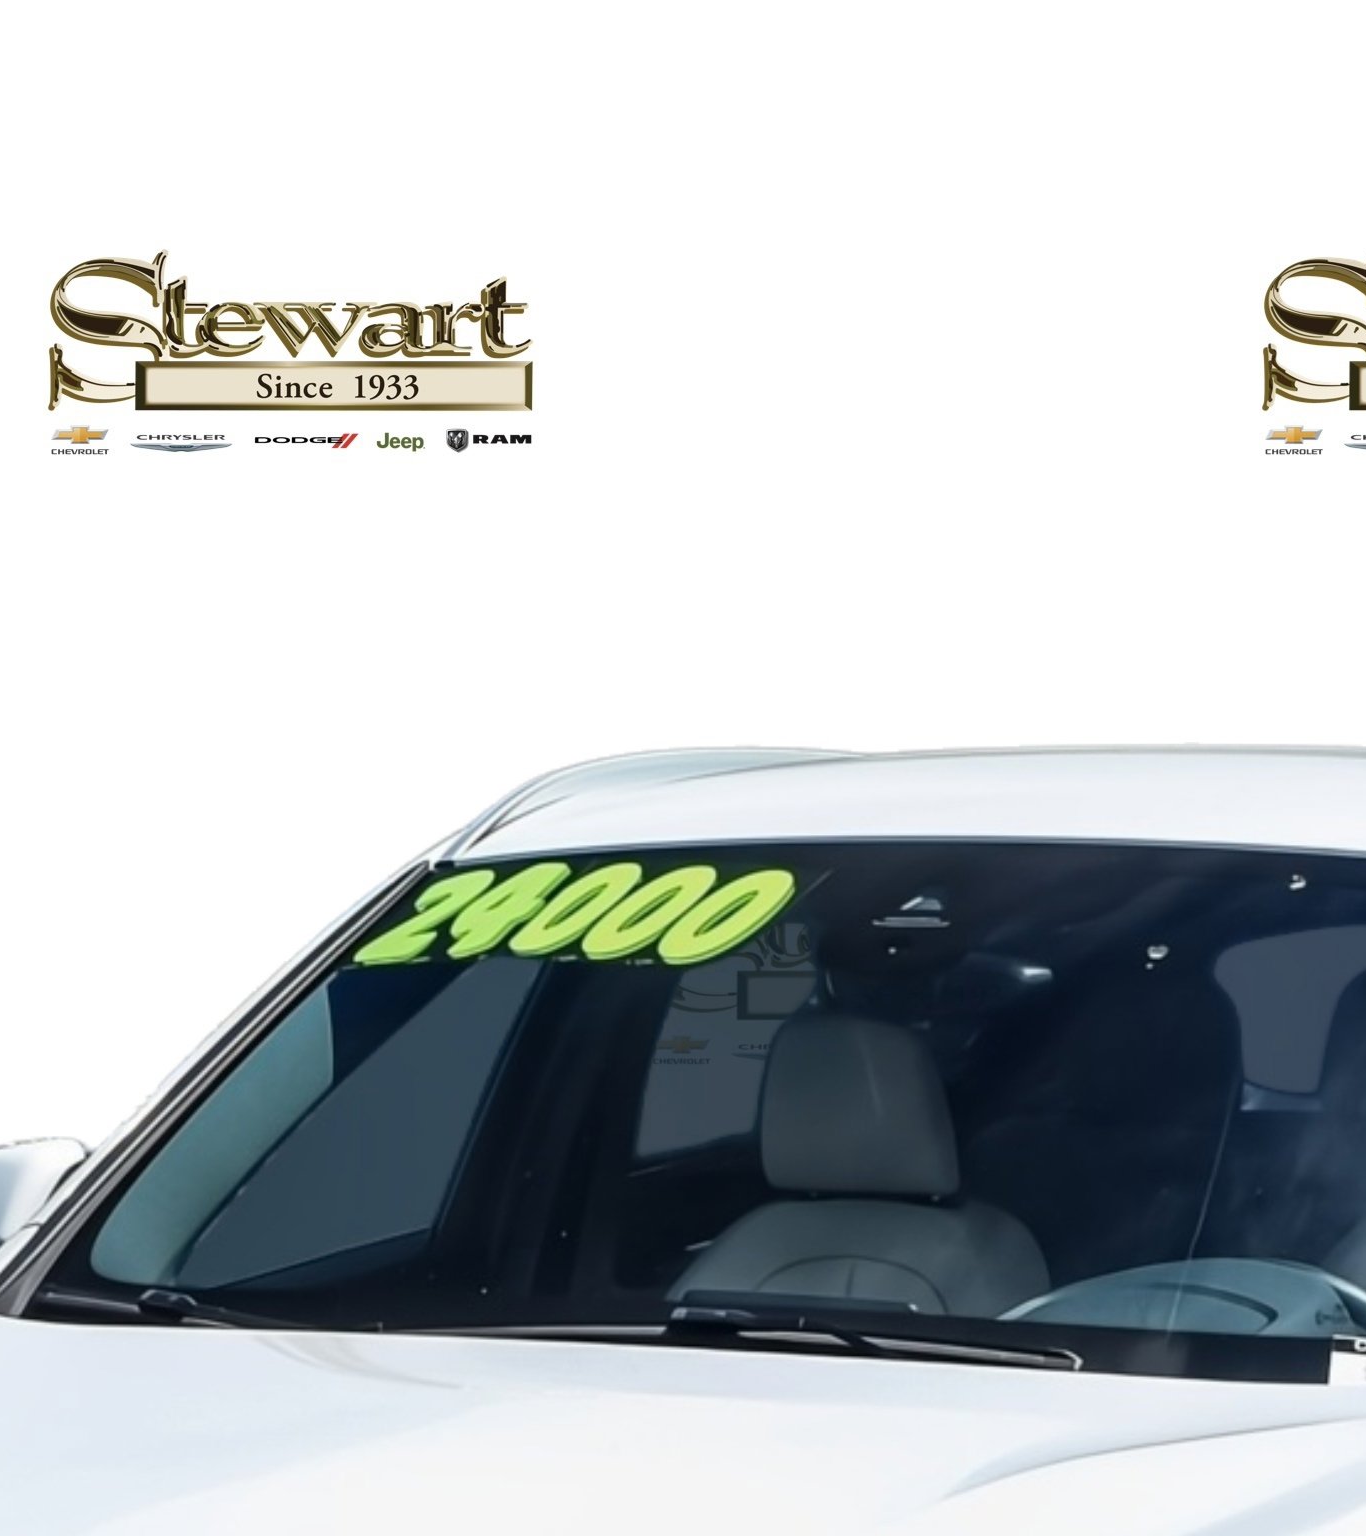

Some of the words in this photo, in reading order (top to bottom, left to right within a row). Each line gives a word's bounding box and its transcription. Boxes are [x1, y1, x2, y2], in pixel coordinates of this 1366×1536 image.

[49, 249, 532, 411] Stewart
[256, 372, 333, 399] Since
[355, 373, 420, 400] 1933
[136, 433, 226, 441] CHRYSLER
[255, 436, 343, 444] DODGE
[376, 432, 425, 453] Jeep
[472, 434, 533, 445] RAM
[352, 862, 795, 966] 24000
